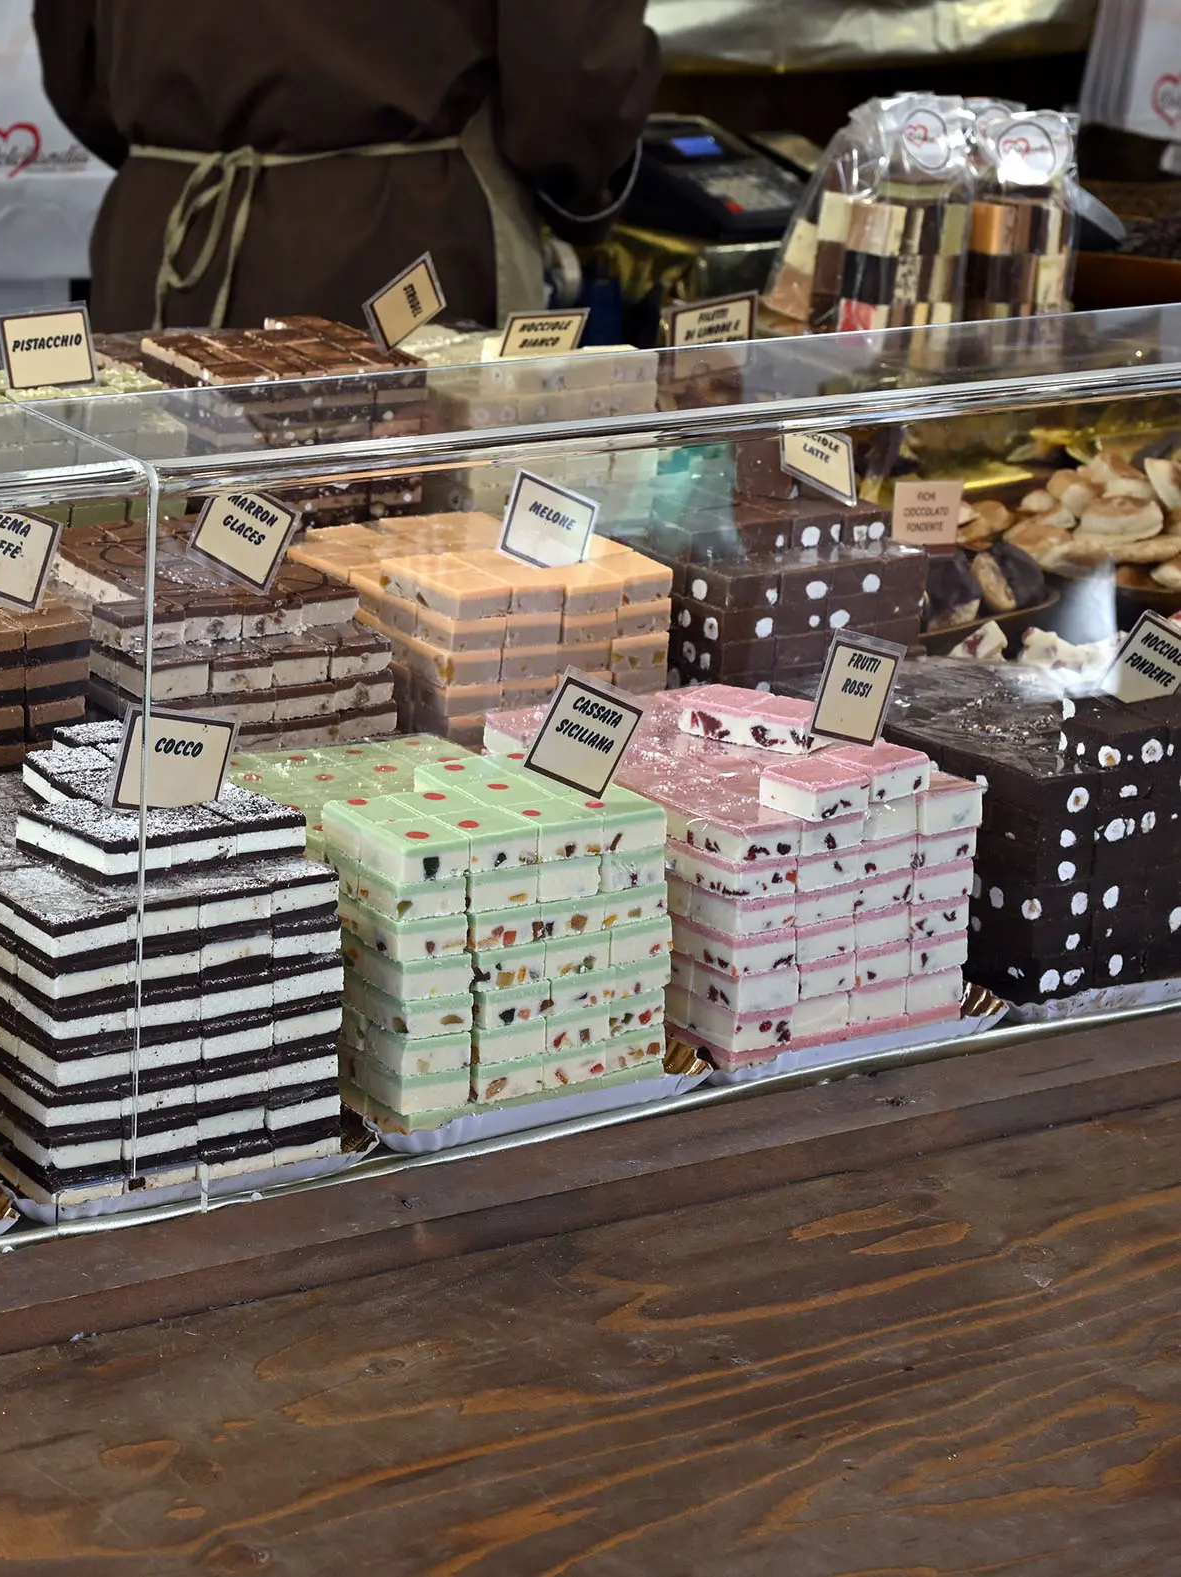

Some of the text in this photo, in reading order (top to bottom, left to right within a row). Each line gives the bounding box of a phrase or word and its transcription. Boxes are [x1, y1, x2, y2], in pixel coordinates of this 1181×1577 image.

[12, 333, 82, 353] PISTACCHIO
[519, 336, 560, 349] BIANCO
[803, 443, 832, 464] LATTE
[227, 494, 279, 528] MARRON
[529, 500, 576, 531] MELONE
[222, 514, 267, 546] GLACES
[847, 652, 882, 674] FRUTTI
[1140, 631, 1181, 667] NOCCIOL
[1124, 651, 1177, 688] FONDENTE
[841, 678, 873, 698] ROSSI
[572, 695, 624, 729] CASSATA
[154, 737, 204, 758] COCCO
[554, 718, 616, 755] SICILIANA
